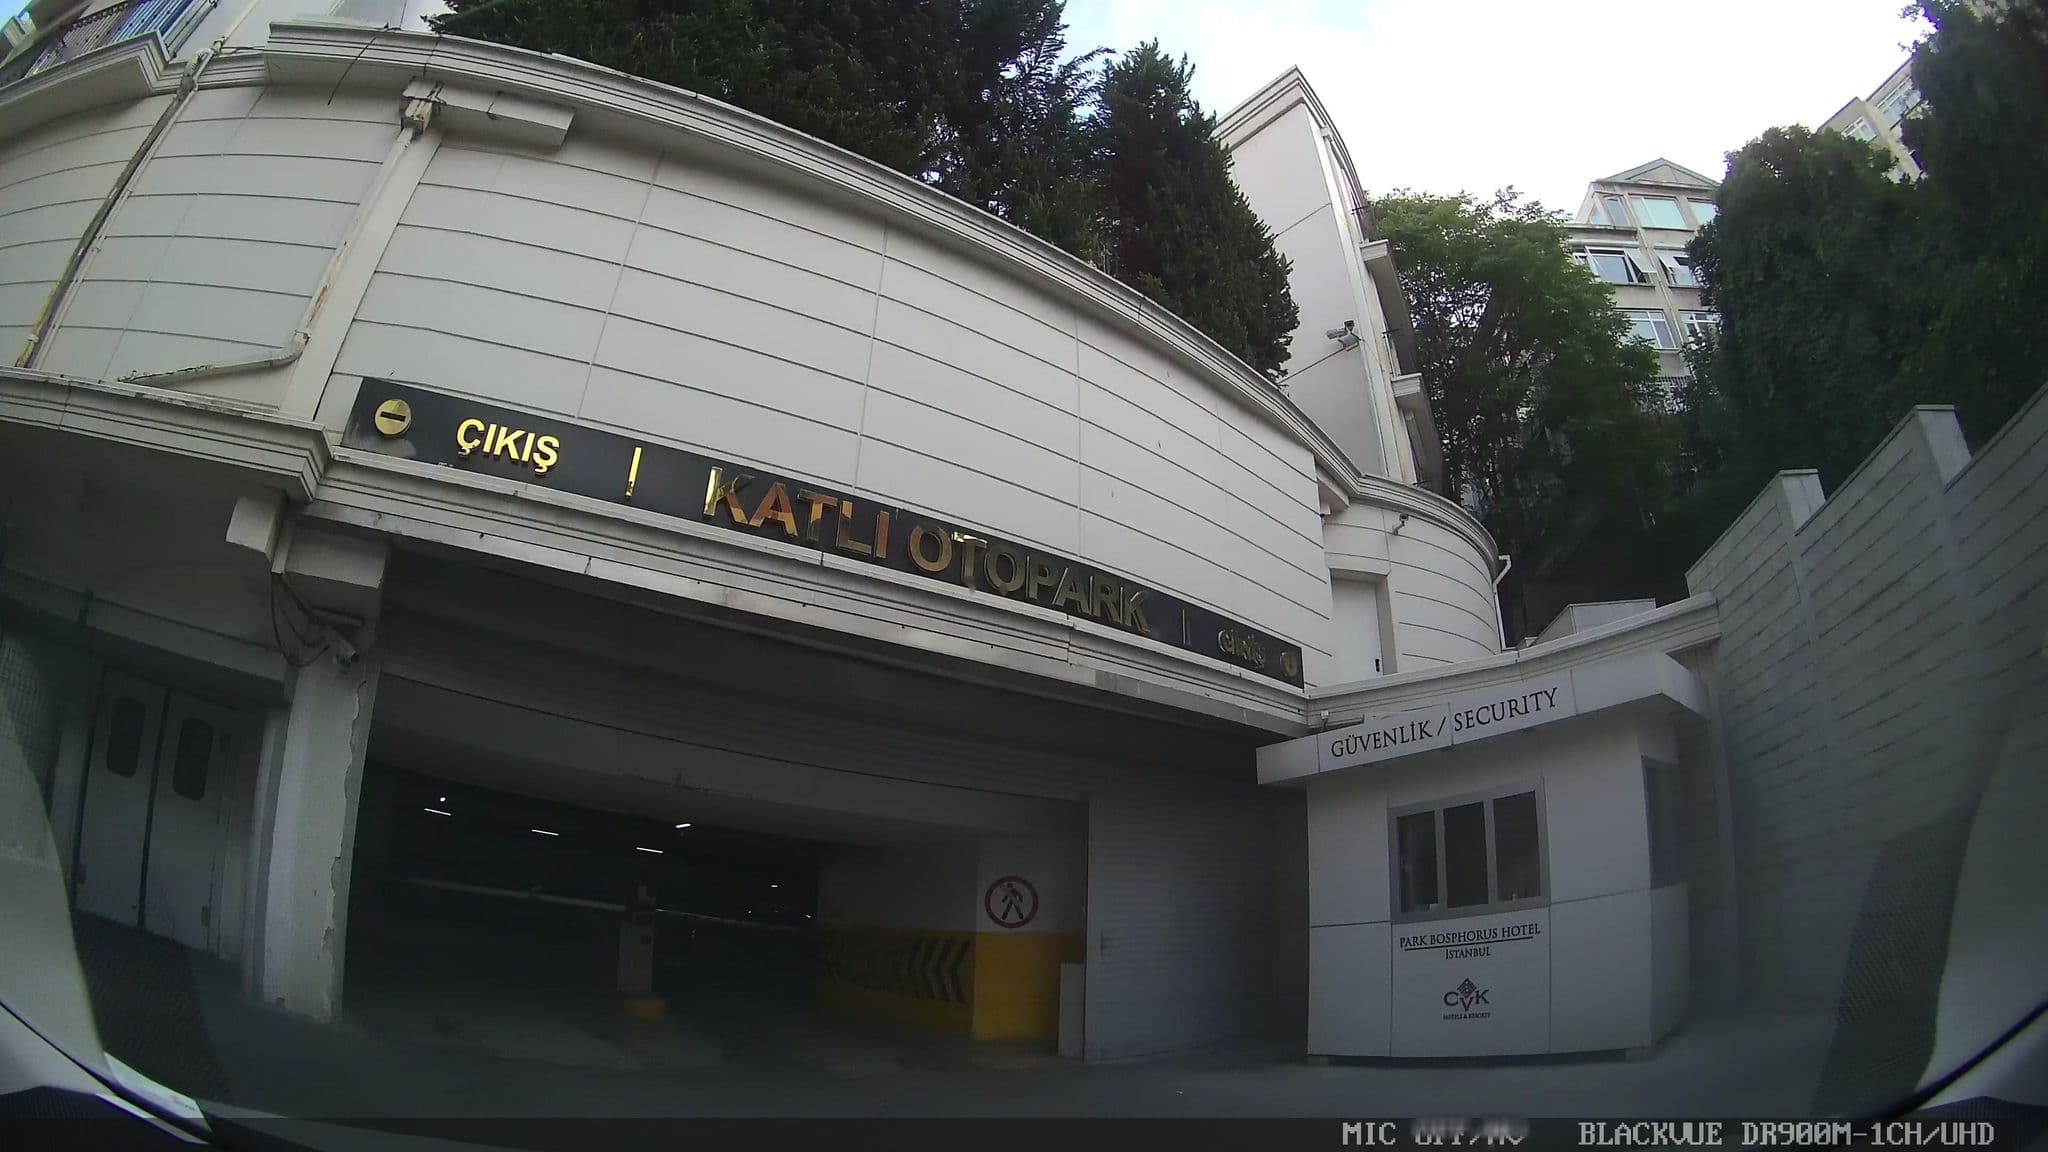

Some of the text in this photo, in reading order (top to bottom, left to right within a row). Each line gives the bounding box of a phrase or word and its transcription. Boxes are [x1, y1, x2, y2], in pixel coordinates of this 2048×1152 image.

[456, 418, 560, 474] ÇIKIŞ
[703, 466, 1151, 633] KATLI OTOPARK
[1331, 716, 1432, 758] GÜVENLİK
[1454, 687, 1558, 731] SECURITY
[1400, 923, 1541, 948] PARK BOSPHORUS HOTEL
[1443, 989, 1490, 1012] CVK
